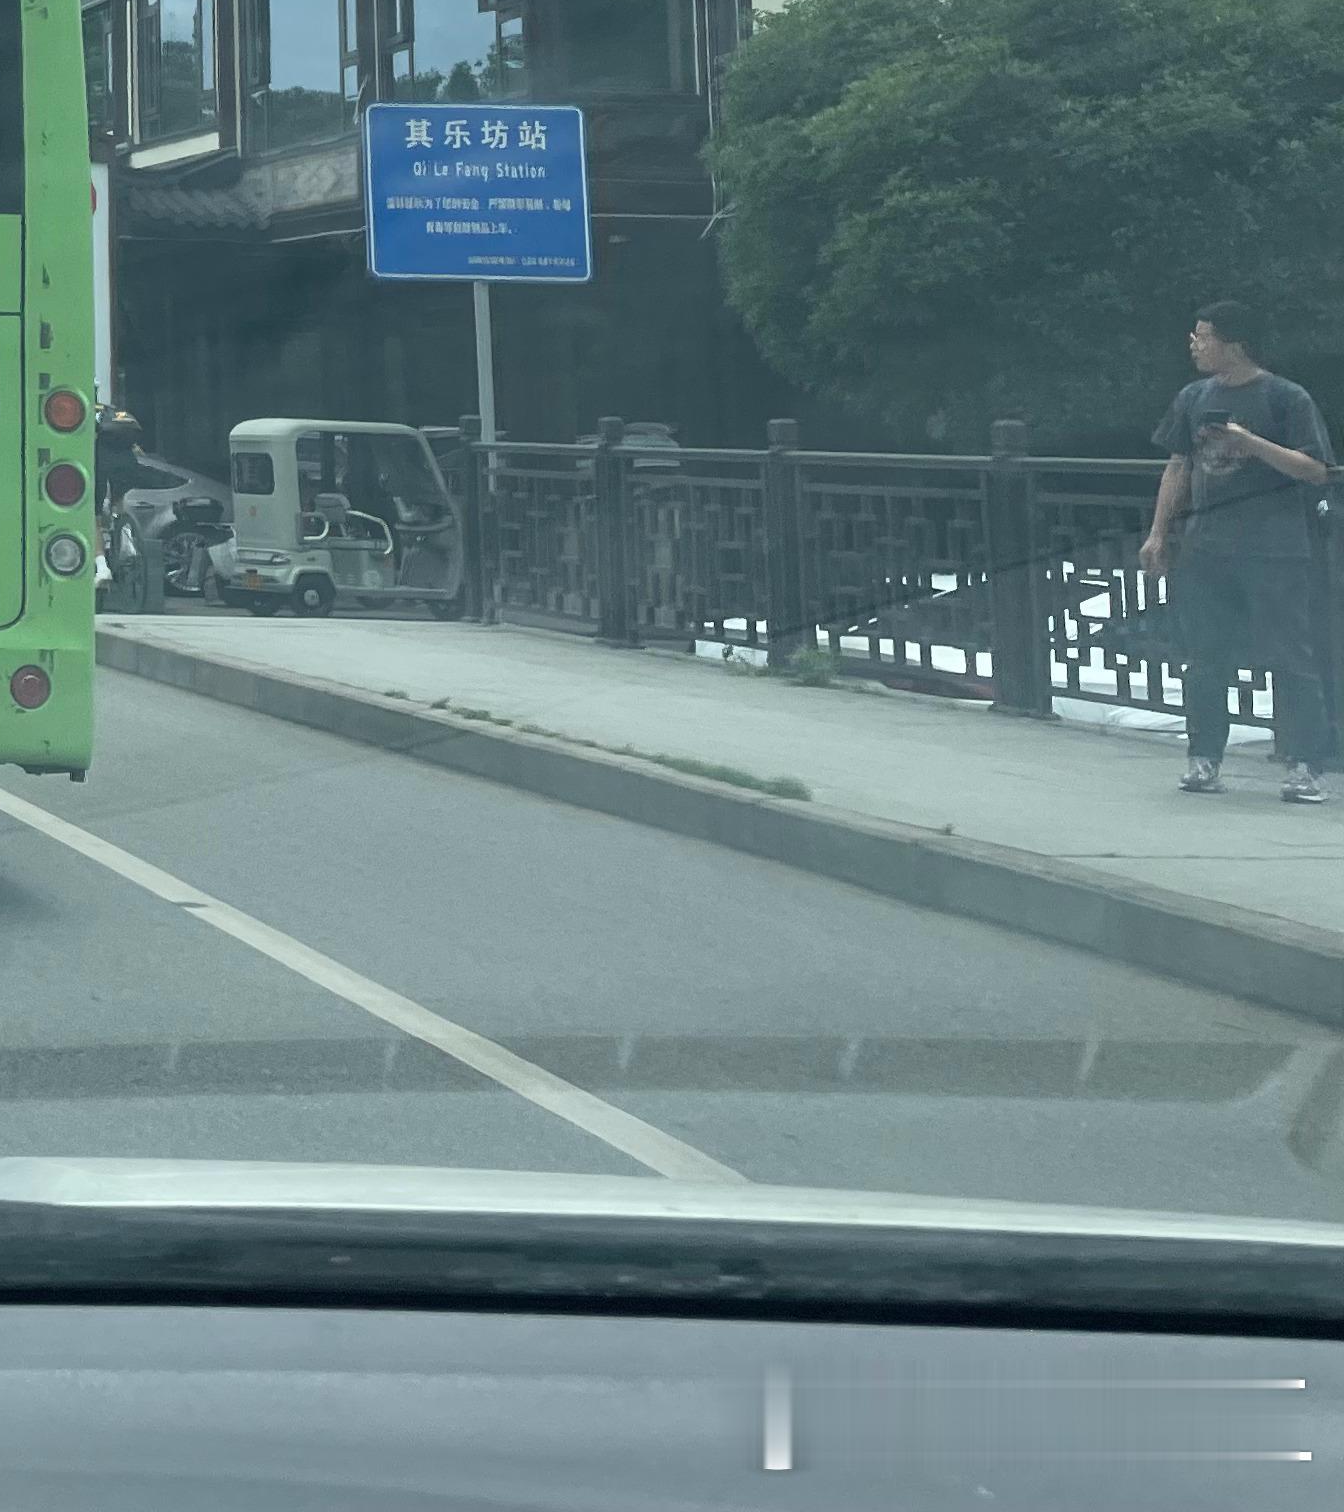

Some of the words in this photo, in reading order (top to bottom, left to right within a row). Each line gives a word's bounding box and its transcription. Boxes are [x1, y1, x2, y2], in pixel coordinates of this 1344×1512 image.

[404, 118, 547, 150] 其乐坊站
[413, 160, 427, 177] Qi
[434, 162, 448, 176] Le
[456, 162, 489, 181] Fang
[496, 162, 546, 178] Station
